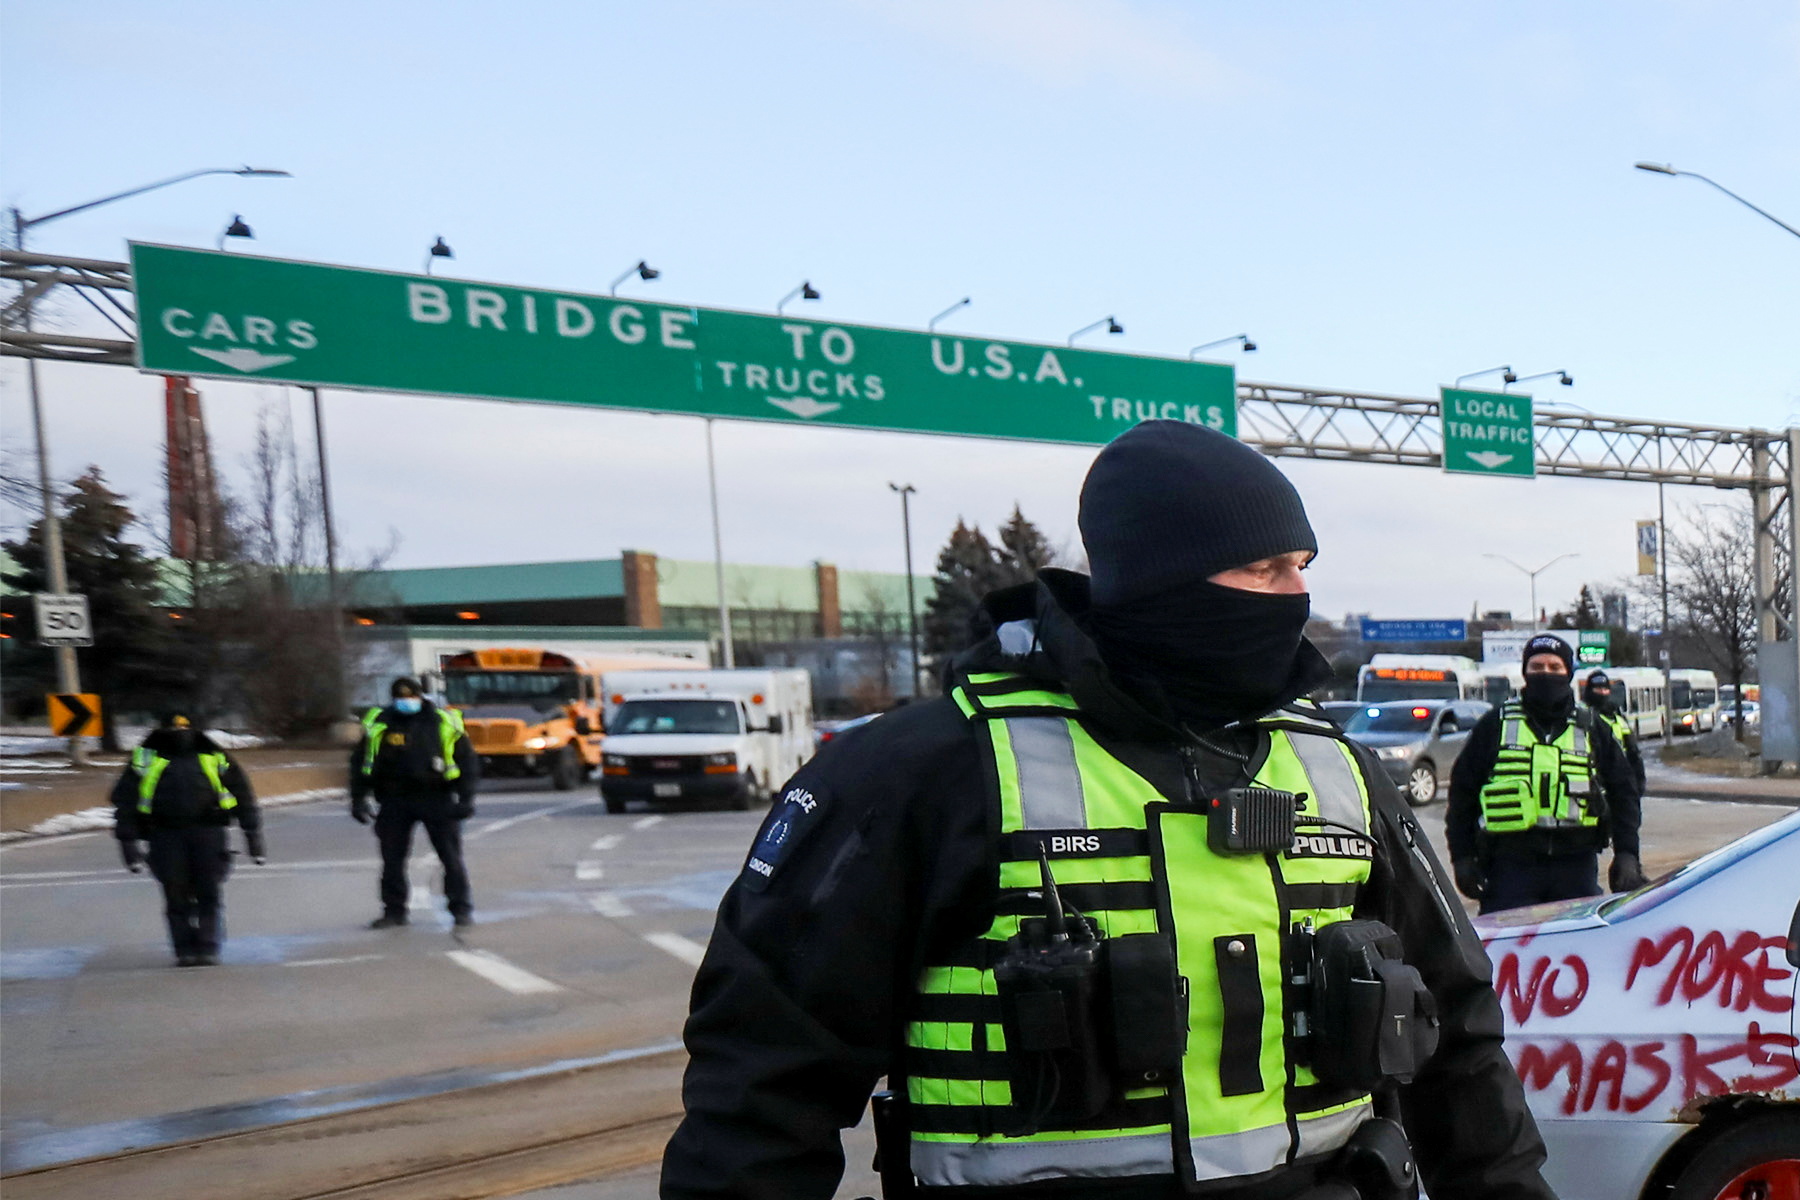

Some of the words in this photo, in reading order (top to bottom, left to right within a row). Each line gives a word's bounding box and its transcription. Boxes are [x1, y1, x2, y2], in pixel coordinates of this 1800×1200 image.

[161, 306, 319, 350] CARS
[406, 282, 696, 350] BRIDGE
[782, 323, 856, 366] TO
[930, 338, 1085, 389] U.S.A.
[716, 361, 886, 401] TRUCKS
[1088, 394, 1225, 431] TRUCKS
[1455, 398, 1520, 421] LOCAL
[1447, 421, 1530, 445] TRAFFIC
[48, 611, 83, 630] 50
[784, 788, 817, 814] POLICE
[1051, 835, 1100, 853] BIRS
[748, 856, 774, 877] LONDON
[1496, 952, 1590, 1028] NO
[1623, 926, 1796, 1014] MORE
